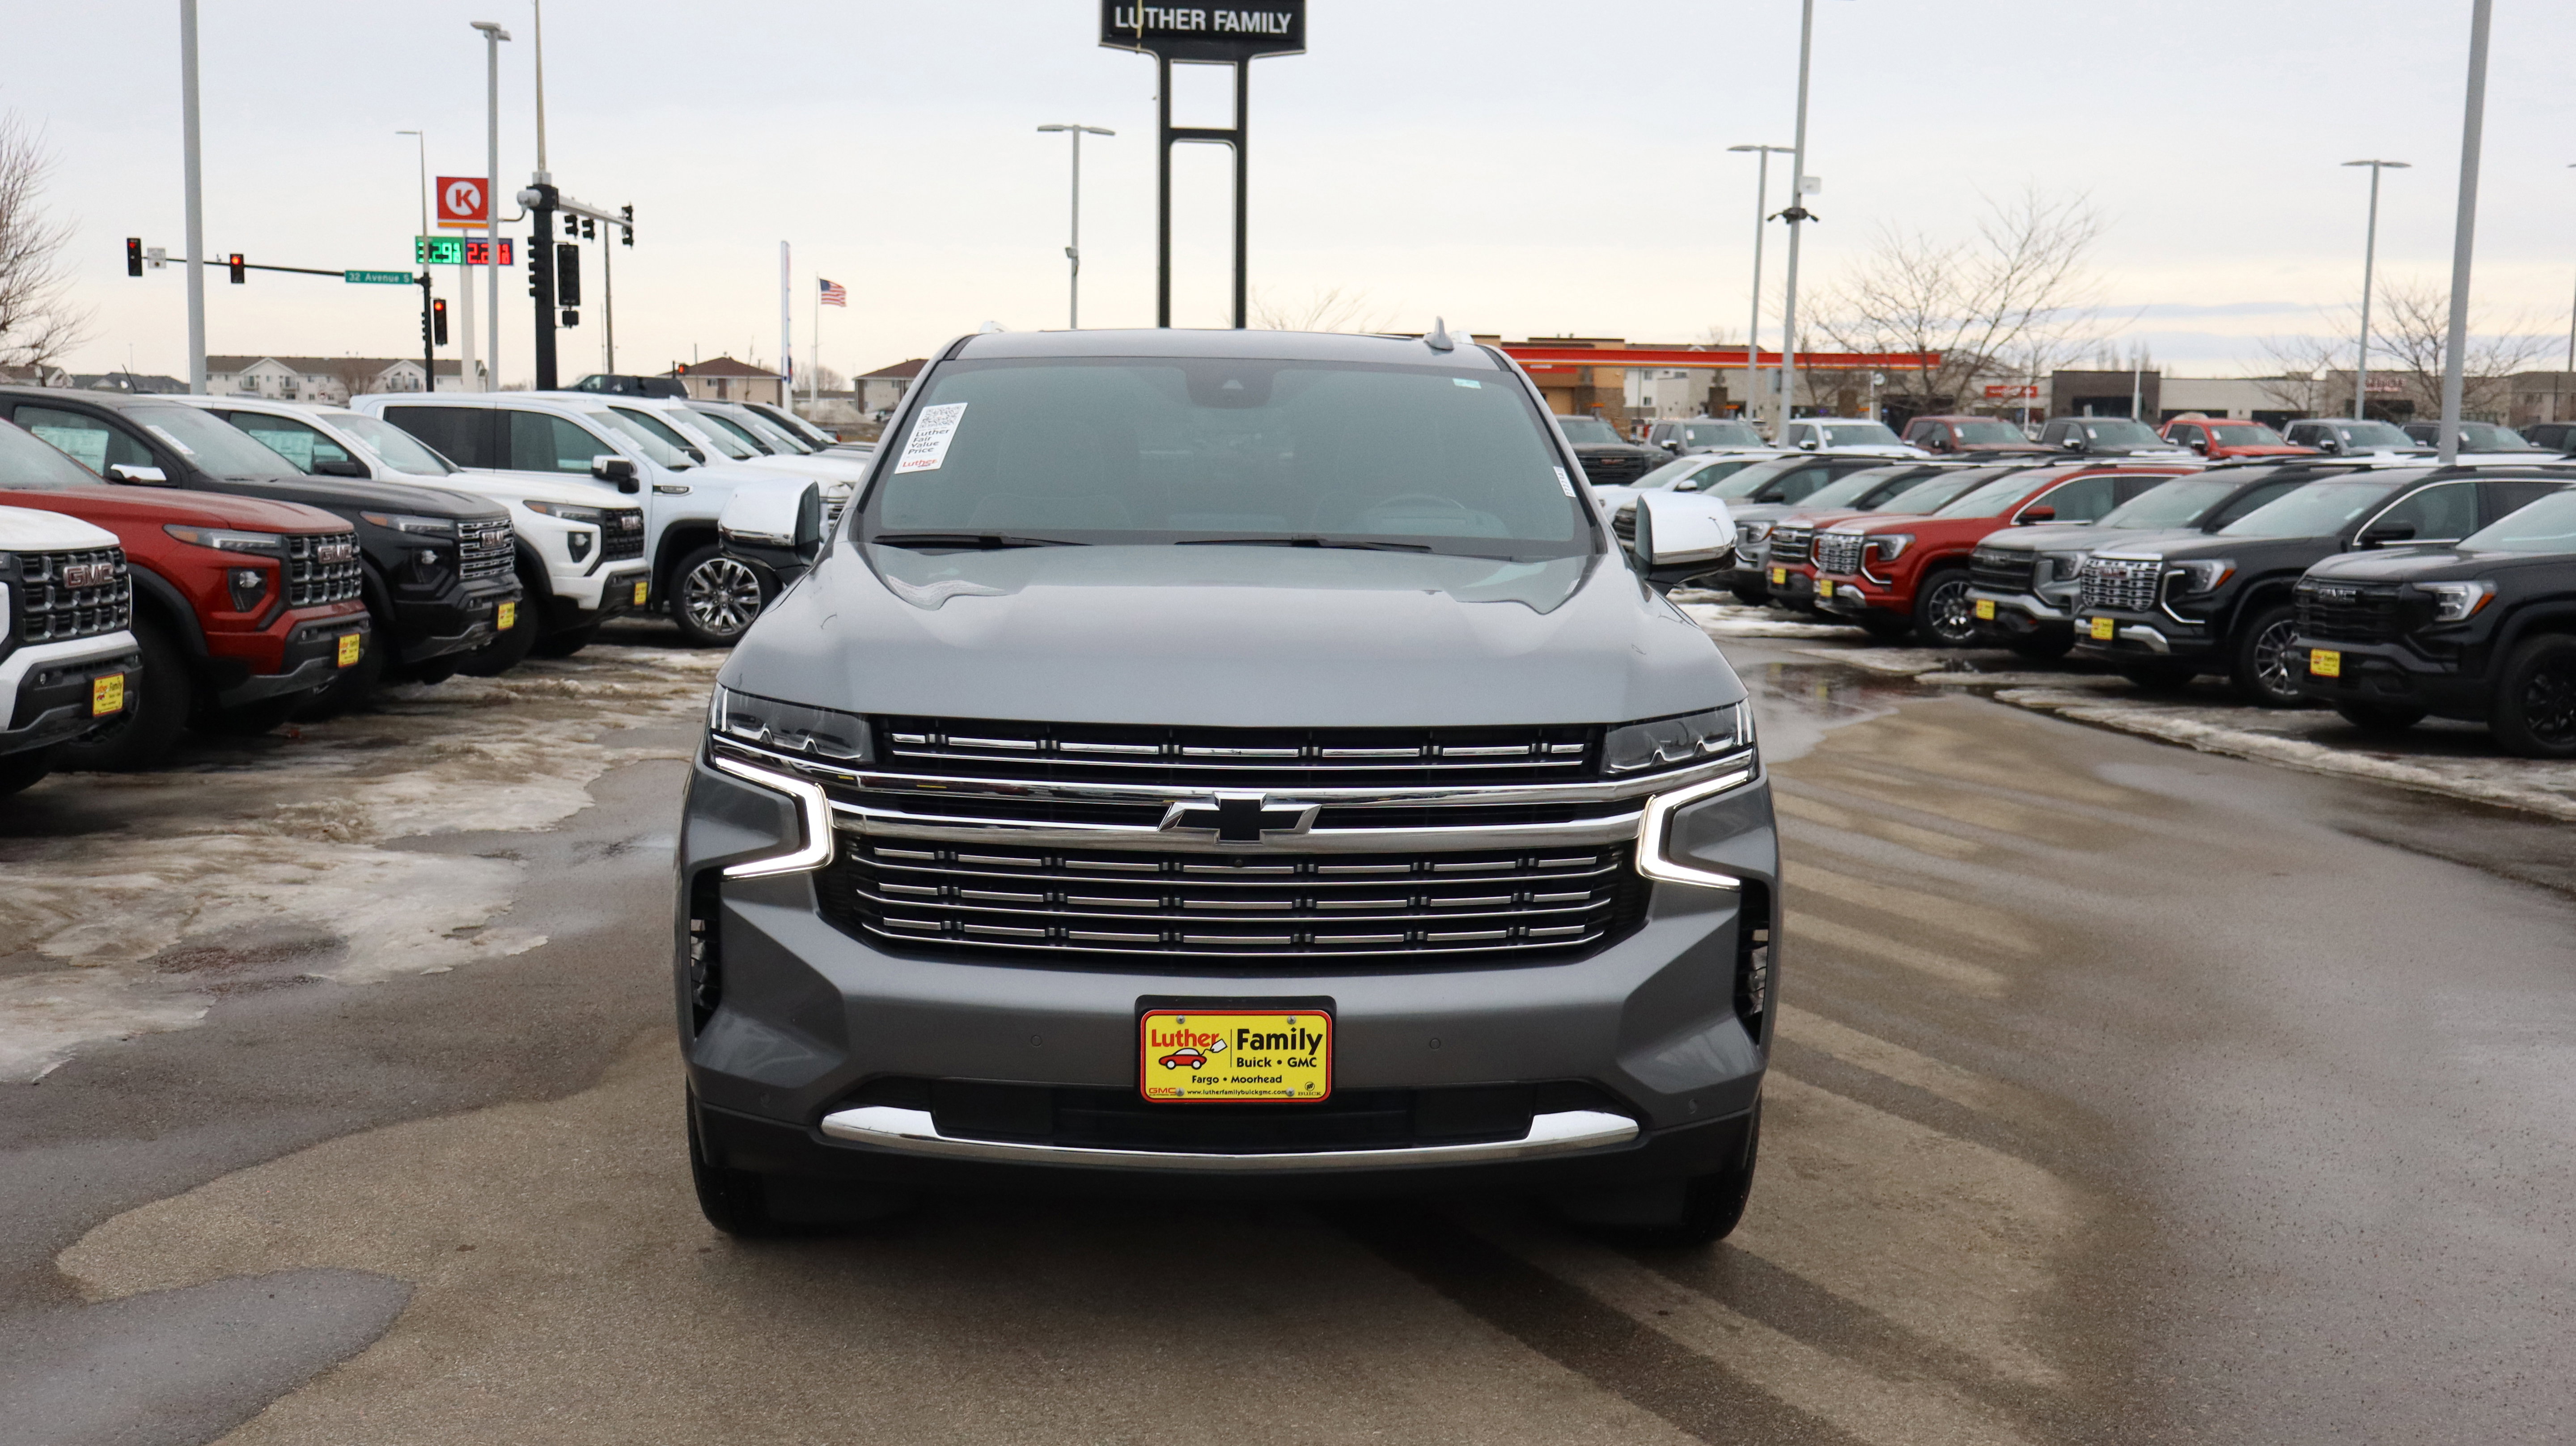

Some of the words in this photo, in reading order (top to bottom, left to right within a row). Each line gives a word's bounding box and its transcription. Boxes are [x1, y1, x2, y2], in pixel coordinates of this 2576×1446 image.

[1115, 7, 1206, 31] LUTHER
[1213, 10, 1292, 34] FAMILY
[455, 189, 477, 214] K
[349, 272, 361, 282] 32
[365, 273, 399, 283] Avenue
[403, 274, 410, 283] S
[902, 459, 937, 467] Luther
[64, 563, 114, 589] GMC
[1151, 1029, 1220, 1047] Luther
[1236, 1027, 1323, 1055] Family
[1236, 1057, 1272, 1068] Buick
[1287, 1057, 1317, 1068] GMC
[1192, 1075, 1219, 1085] Fargo
[1231, 1075, 1283, 1084] Moorhead
